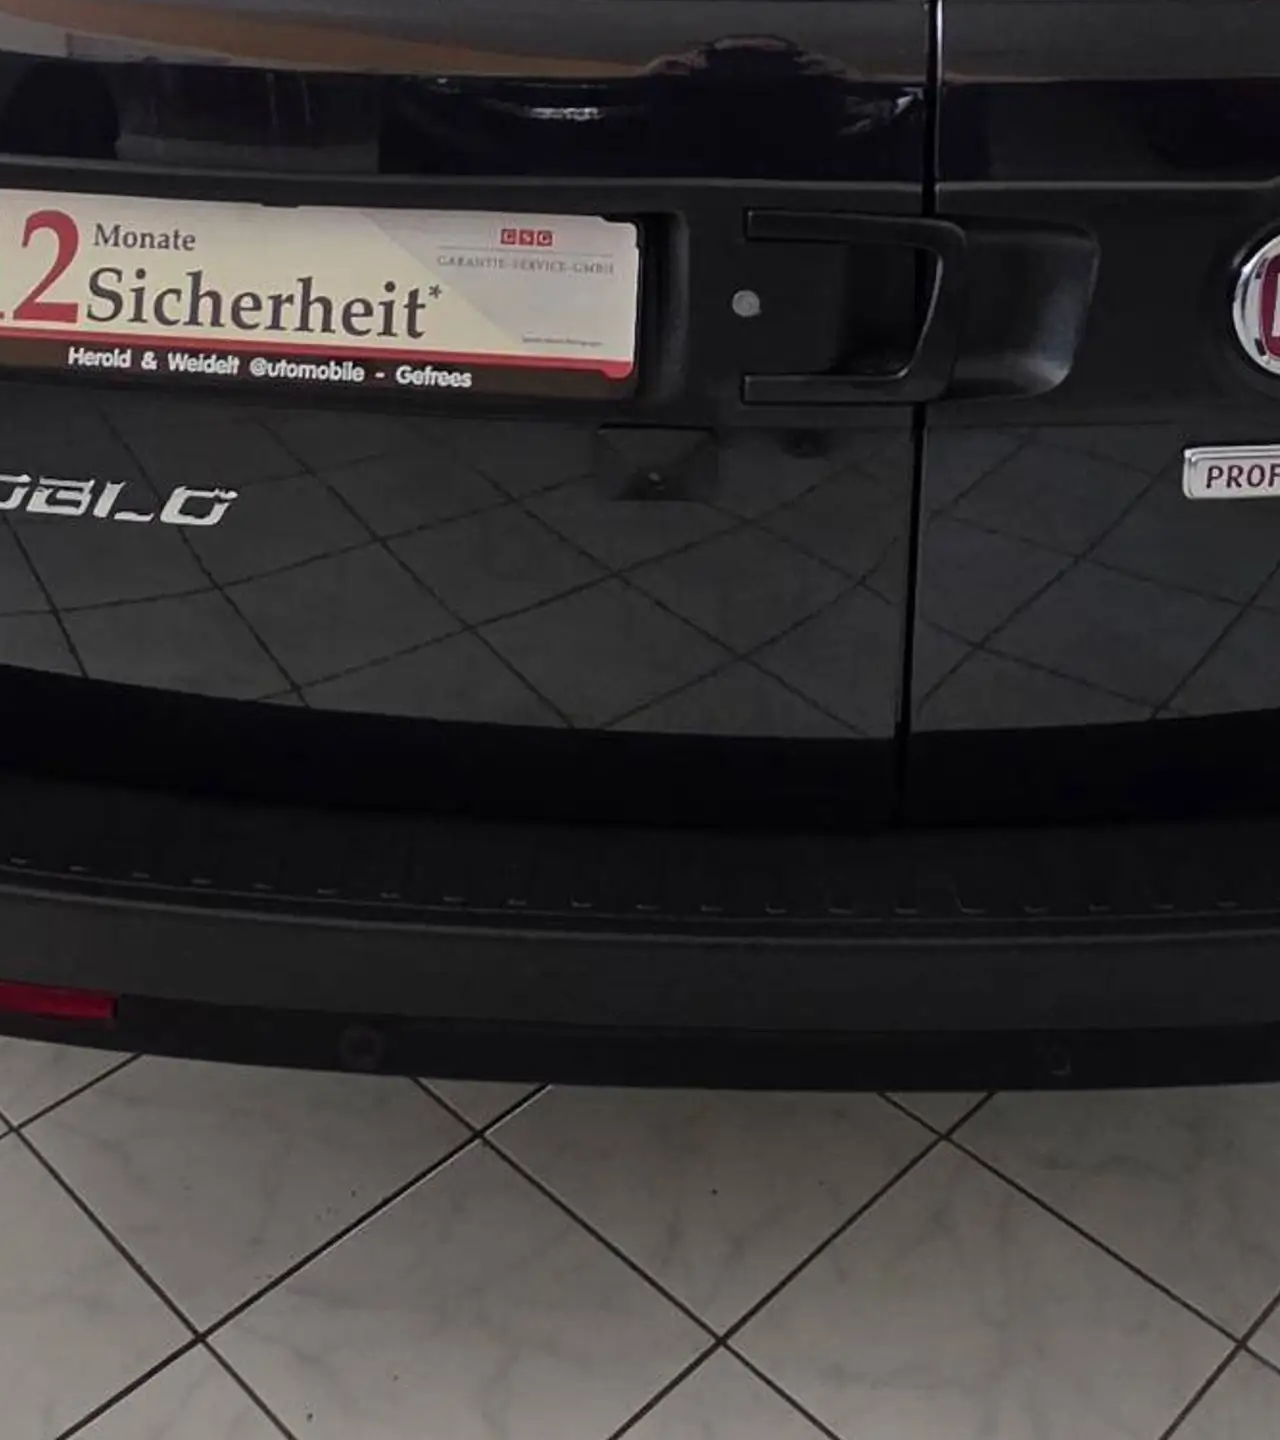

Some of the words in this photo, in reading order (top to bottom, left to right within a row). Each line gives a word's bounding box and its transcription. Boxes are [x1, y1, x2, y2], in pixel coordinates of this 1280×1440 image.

[93, 222, 196, 251] Monate
[67, 345, 132, 369] Herold
[140, 350, 158, 370] &
[167, 351, 241, 376] Weidelt
[248, 355, 365, 382] @utomobile
[395, 365, 473, 388] Gefrees
